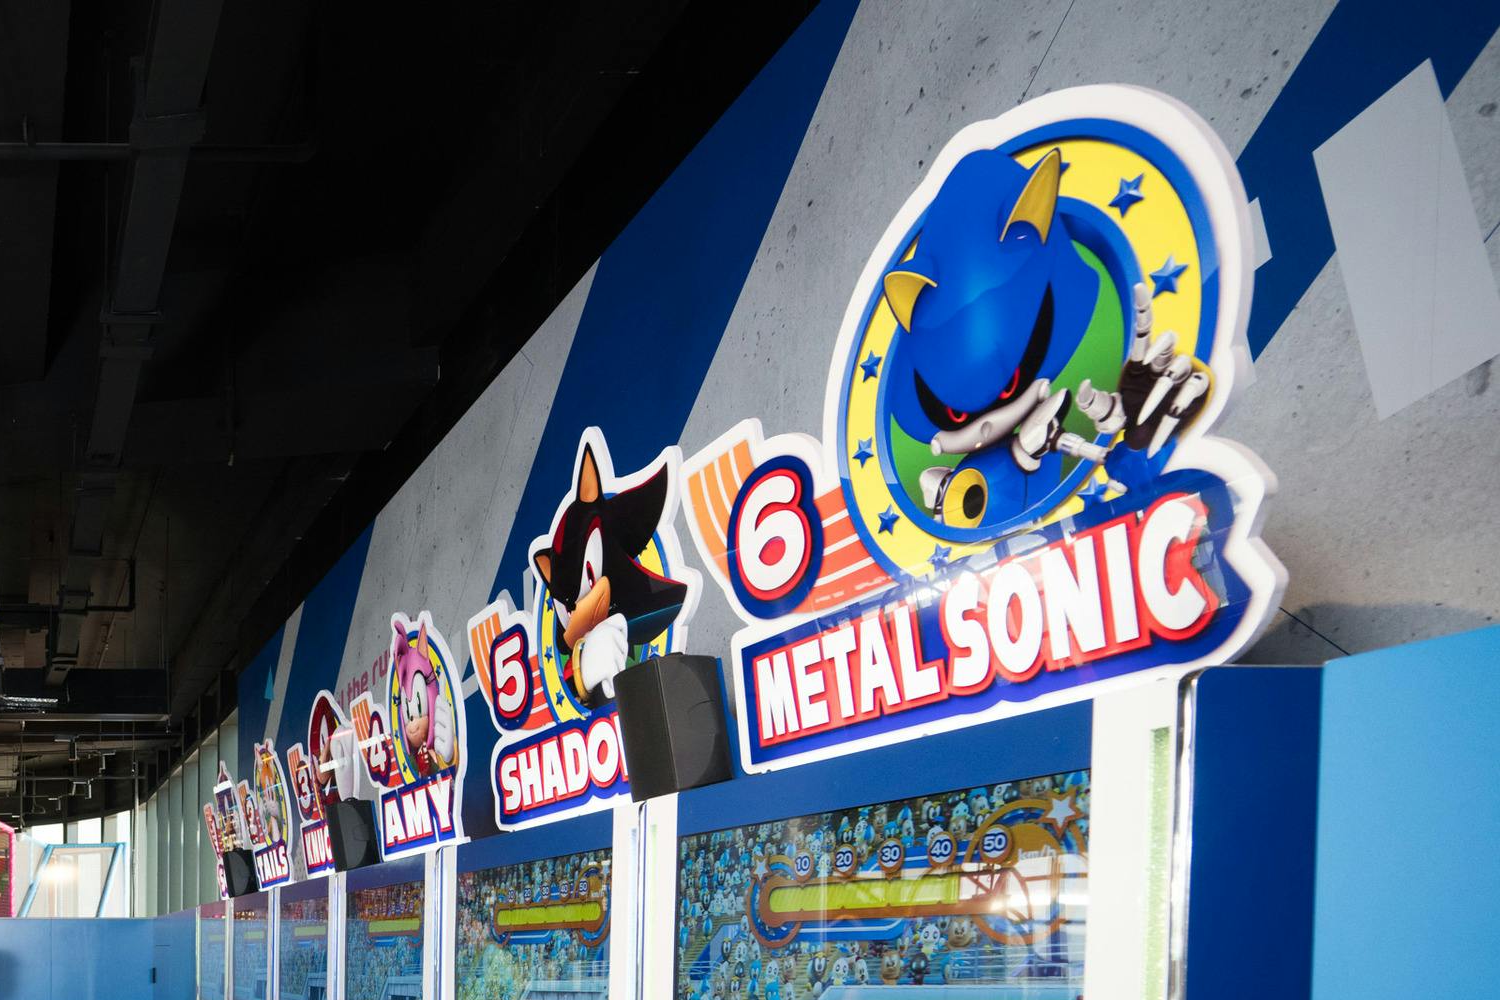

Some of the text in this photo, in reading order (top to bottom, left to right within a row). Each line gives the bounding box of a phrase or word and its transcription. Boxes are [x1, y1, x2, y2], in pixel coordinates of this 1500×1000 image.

[735, 470, 804, 595] 6
[754, 495, 1208, 742] METAL SONIC
[372, 650, 390, 686] ru
[492, 636, 528, 716] 5
[370, 718, 387, 772] 4
[500, 716, 626, 815] SHADO
[297, 769, 311, 809] 3
[383, 776, 453, 845] AMY
[256, 845, 289, 882] TAILS
[303, 823, 334, 868] KNUC
[794, 856, 811, 873] 10
[835, 850, 853, 868] 20
[880, 844, 899, 863] 30
[930, 837, 953, 857] 40
[982, 832, 1007, 853] 50
